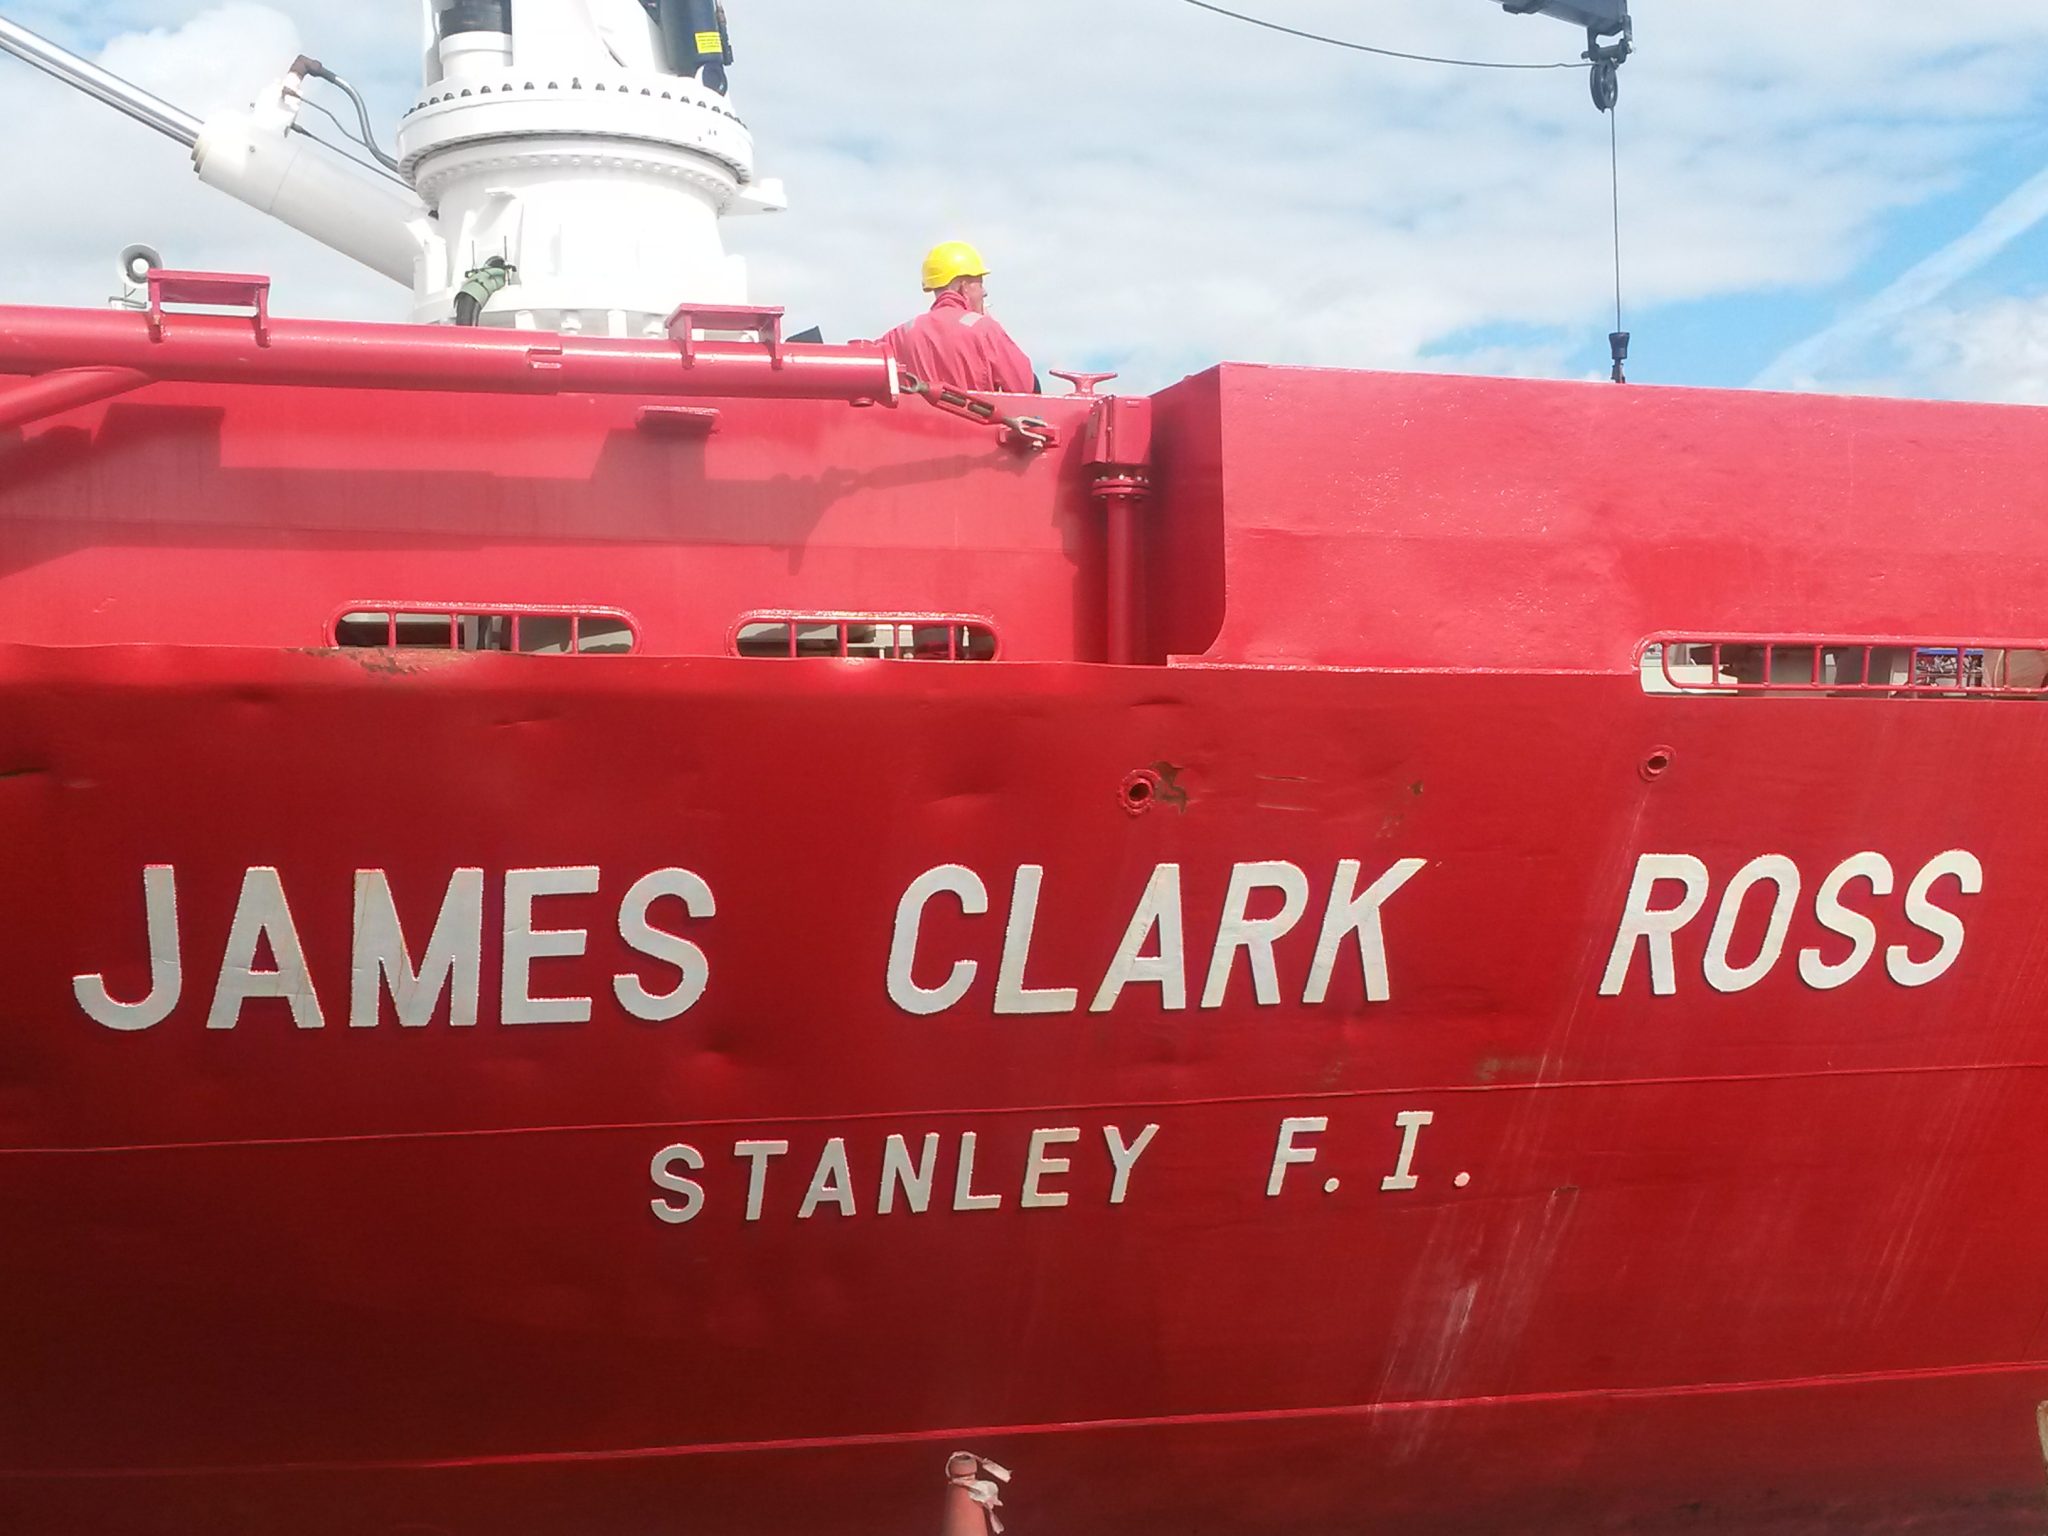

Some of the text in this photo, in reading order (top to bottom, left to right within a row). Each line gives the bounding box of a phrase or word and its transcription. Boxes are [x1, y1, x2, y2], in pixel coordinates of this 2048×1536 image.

[70, 848, 1985, 1033] JAMES CLARK ROSS
[648, 1122, 1161, 1226] STANLEY
